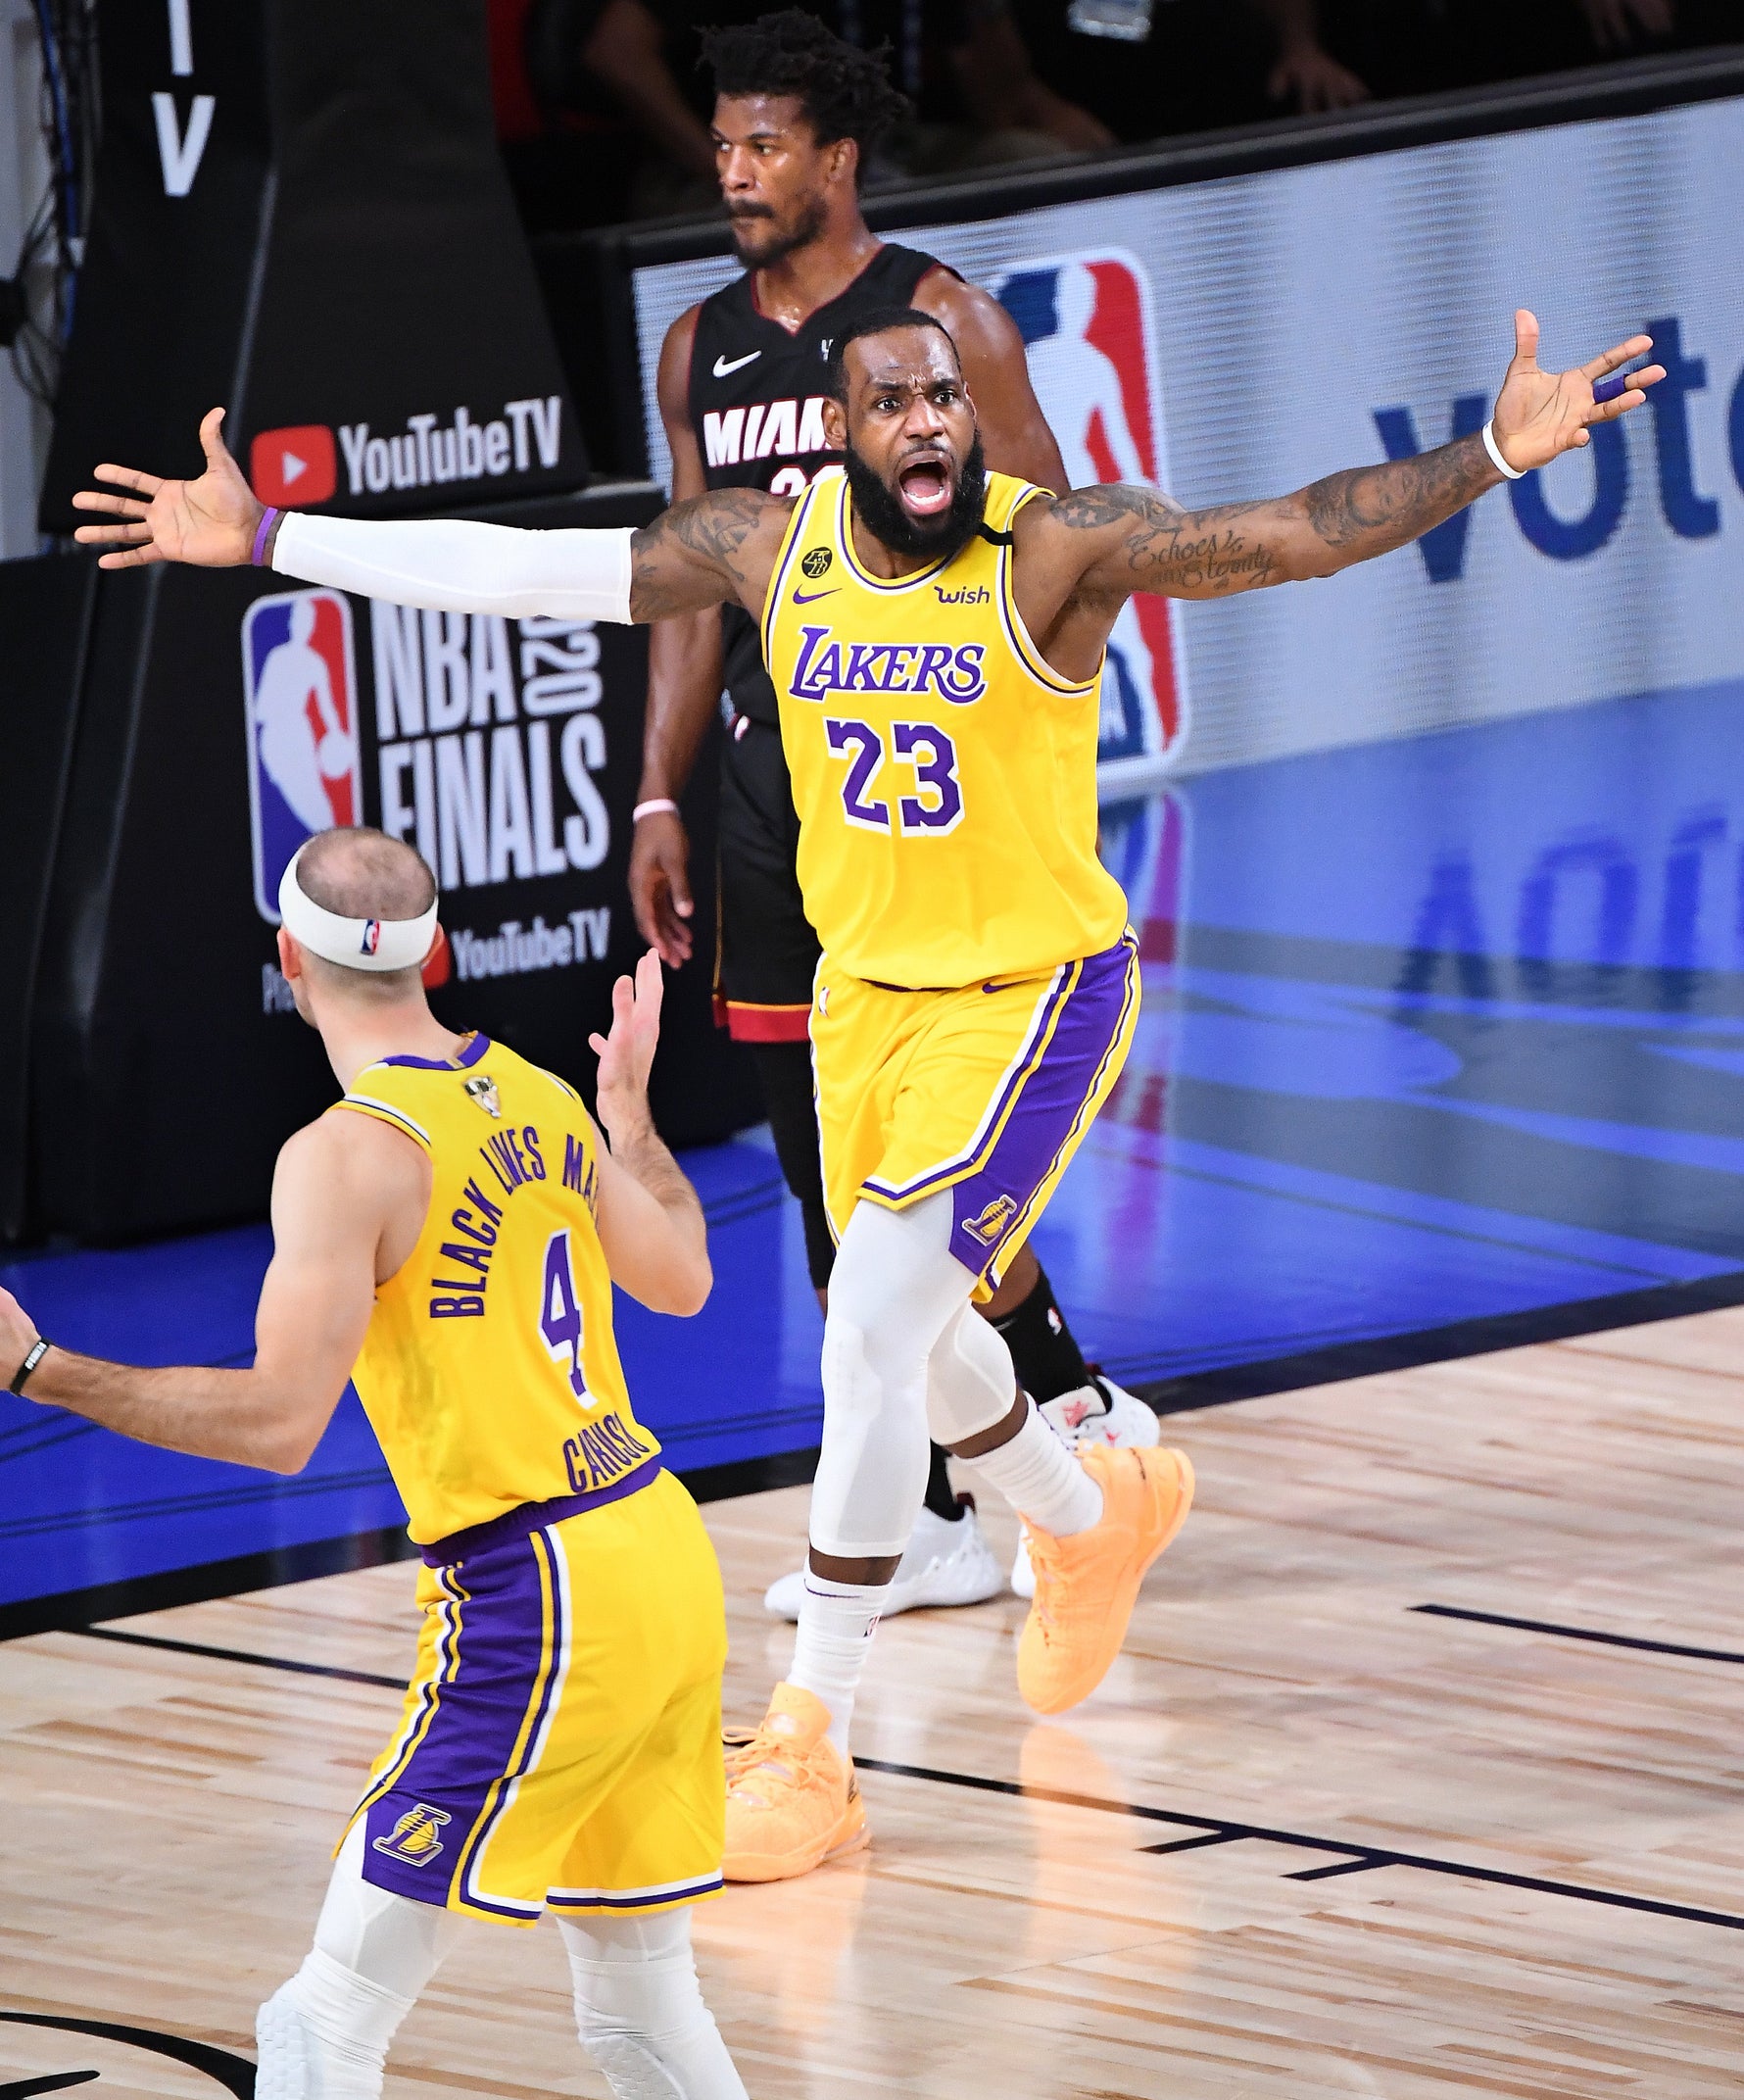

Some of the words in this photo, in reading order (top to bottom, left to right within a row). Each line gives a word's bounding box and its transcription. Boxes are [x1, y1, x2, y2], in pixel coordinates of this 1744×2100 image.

[702, 394, 834, 468] MIAM
[1375, 317, 1744, 584] vot
[369, 595, 517, 741] NBA
[788, 625, 987, 706] LAKERS
[934, 585, 991, 605] wish
[379, 713, 610, 893] FINALS
[823, 715, 965, 839] 23
[430, 1177, 504, 1318] BLACK
[479, 1126, 547, 1196] LIVES
[540, 1228, 598, 1409] 4
